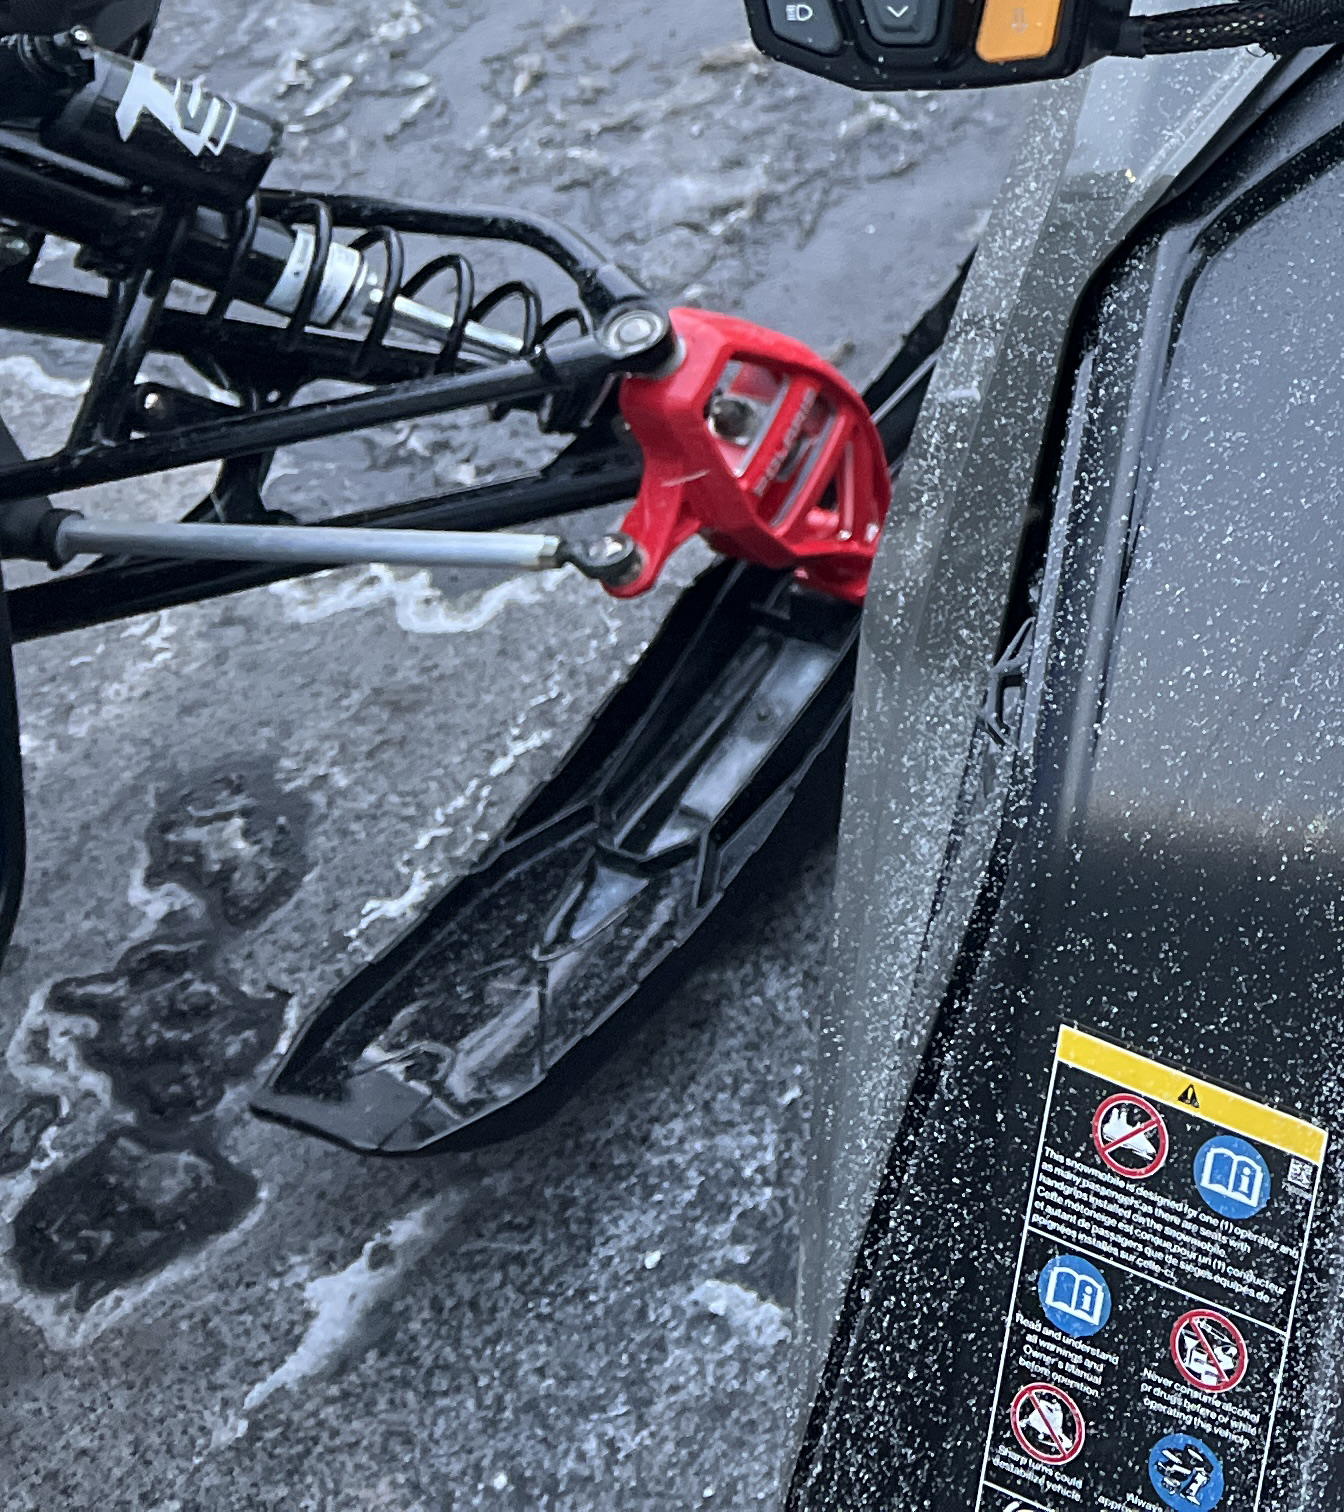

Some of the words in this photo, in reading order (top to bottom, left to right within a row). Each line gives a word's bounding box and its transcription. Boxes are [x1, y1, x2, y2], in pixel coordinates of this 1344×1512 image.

[1039, 1172, 1088, 1201] handgrips
[1089, 1193, 1132, 1219] installed
[1146, 1217, 1163, 1232] the
[1042, 1162, 1054, 1173] as
[1054, 1167, 1081, 1186] many
[1154, 1207, 1181, 1226] there
[1181, 1220, 1199, 1233] are
[1200, 1227, 1228, 1244] seats
[1229, 1238, 1252, 1254] with
[1044, 1146, 1065, 1164] This
[1066, 1157, 1126, 1188] snowmobile
[1136, 1187, 1183, 1212] designed
[1199, 1213, 1219, 1227] one
[1220, 1218, 1234, 1234] (1)
[1234, 1227, 1279, 1250] operator
[1034, 1200, 1045, 1211] et
[1045, 1204, 1077, 1225] autant
[1077, 1217, 1091, 1231] de
[1091, 1224, 1144, 1253] passagers
[1144, 1246, 1164, 1261] que
[1165, 1254, 1179, 1267] de
[1118, 1221, 1134, 1236] est
[1173, 1244, 1199, 1262] pour
[1198, 1253, 1212, 1266] un
[1212, 1258, 1226, 1274] (1)
[1120, 1249, 1137, 1263] sur
[1016, 1312, 1042, 1333] Read
[1042, 1326, 1062, 1342] and
[1062, 1334, 1120, 1366] understand
[1026, 1332, 1038, 1345] all
[1038, 1338, 1083, 1364] warnings
[1083, 1357, 1104, 1373] and
[1064, 1361, 1102, 1386] Manual
[1143, 1367, 1174, 1388] Never
[1174, 1382, 1221, 1408] consume
[1222, 1402, 1260, 1424] alcohol
[1141, 1382, 1153, 1393] or
[1153, 1387, 1183, 1407] drugs
[1184, 1398, 1217, 1420] before
[1218, 1414, 1229, 1425] or
[1144, 1396, 1193, 1426] operating
[1194, 1416, 1213, 1435] this
[1055, 1471, 1084, 1490] could
